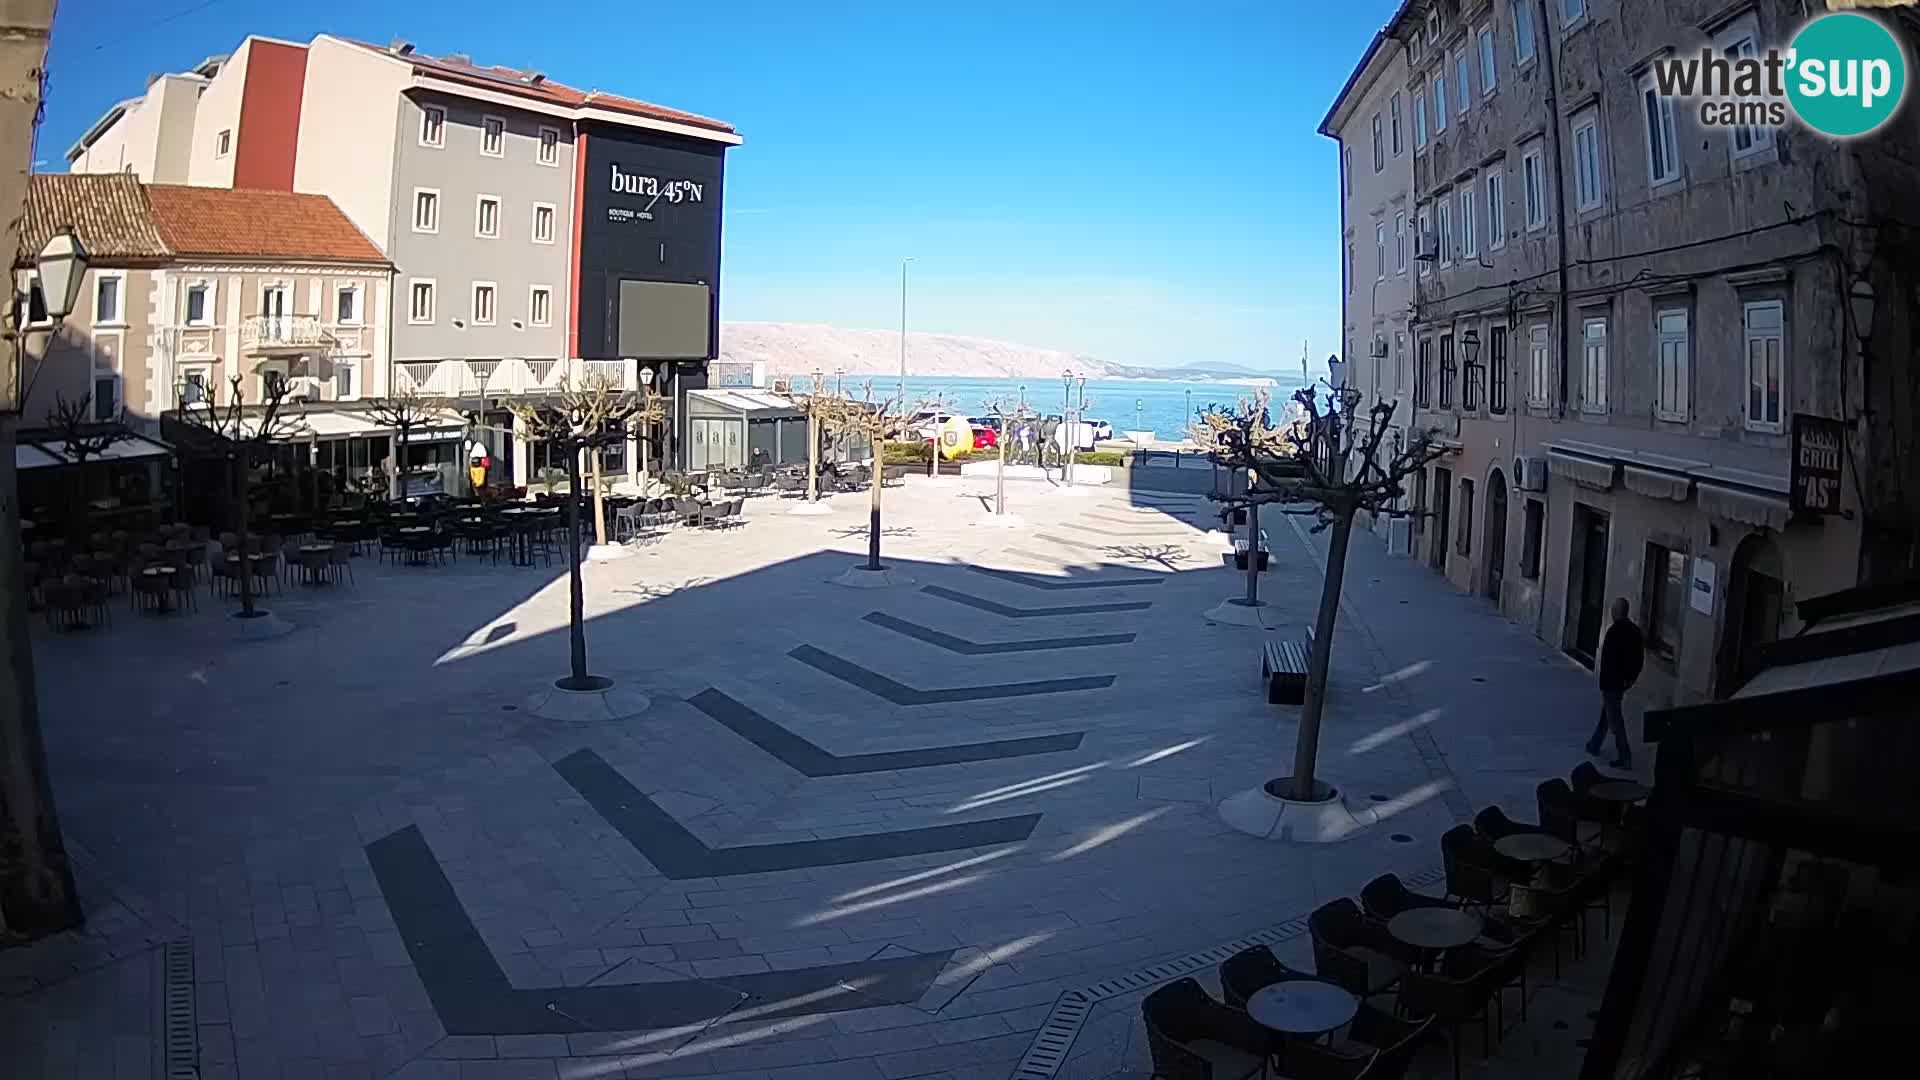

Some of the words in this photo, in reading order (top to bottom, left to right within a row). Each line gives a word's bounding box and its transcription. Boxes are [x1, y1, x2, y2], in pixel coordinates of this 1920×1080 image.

[611, 165, 658, 196] bura
[636, 211, 653, 220] HOTEL
[1799, 446, 1839, 471] GRILL
